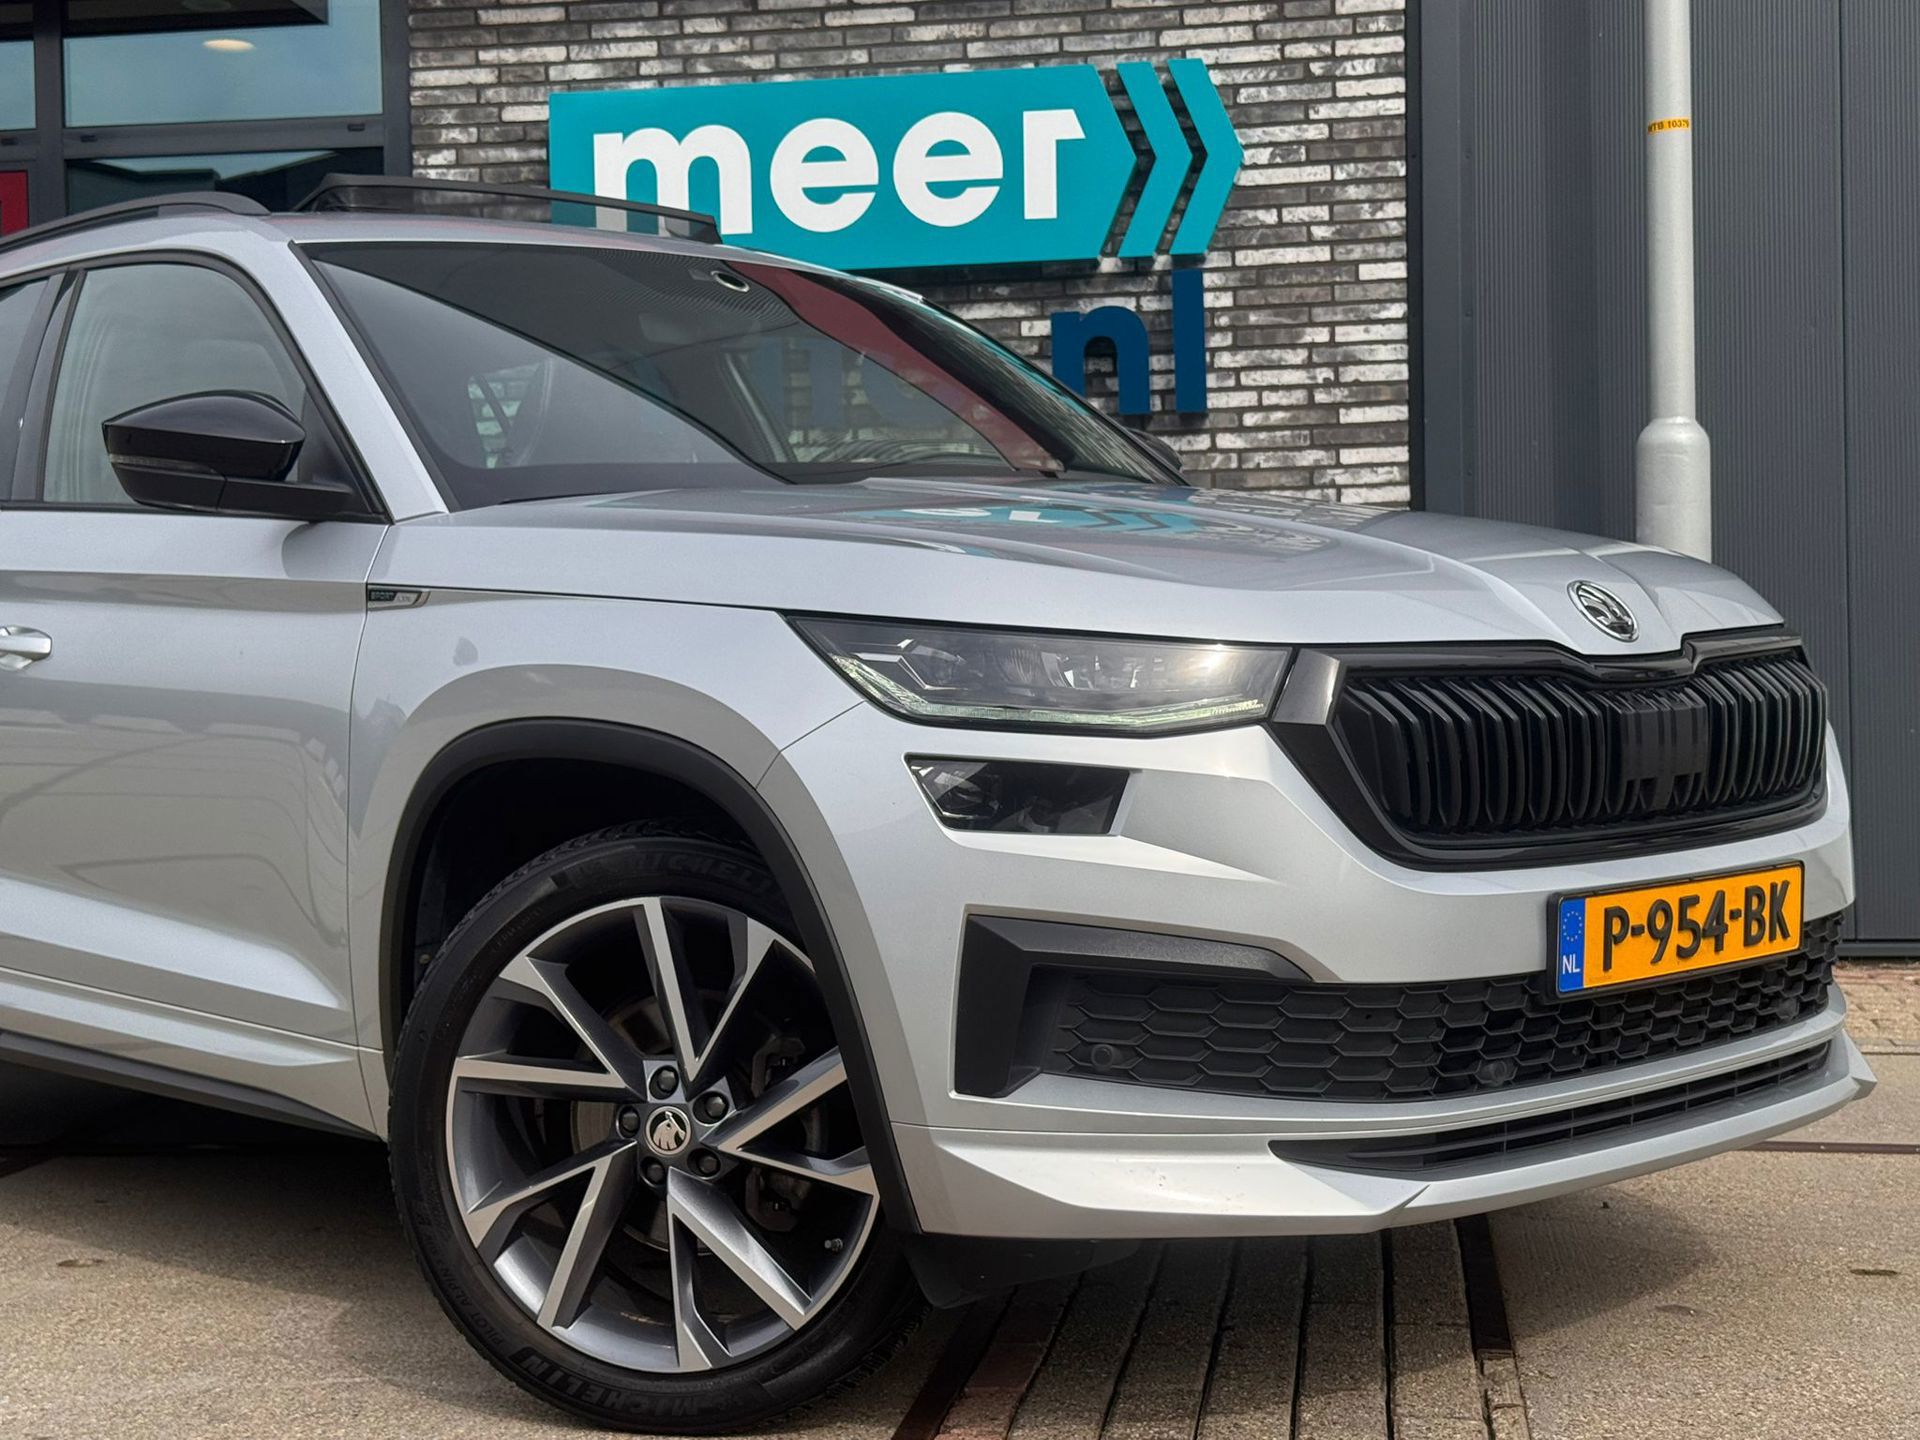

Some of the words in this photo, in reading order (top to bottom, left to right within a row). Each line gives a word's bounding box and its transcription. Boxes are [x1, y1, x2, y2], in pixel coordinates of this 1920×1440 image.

[593, 108, 1086, 235] meer
[1562, 954, 1581, 975] NL
[1602, 880, 1791, 973] P-954-BK
[521, 1355, 701, 1417] MICHELIN
